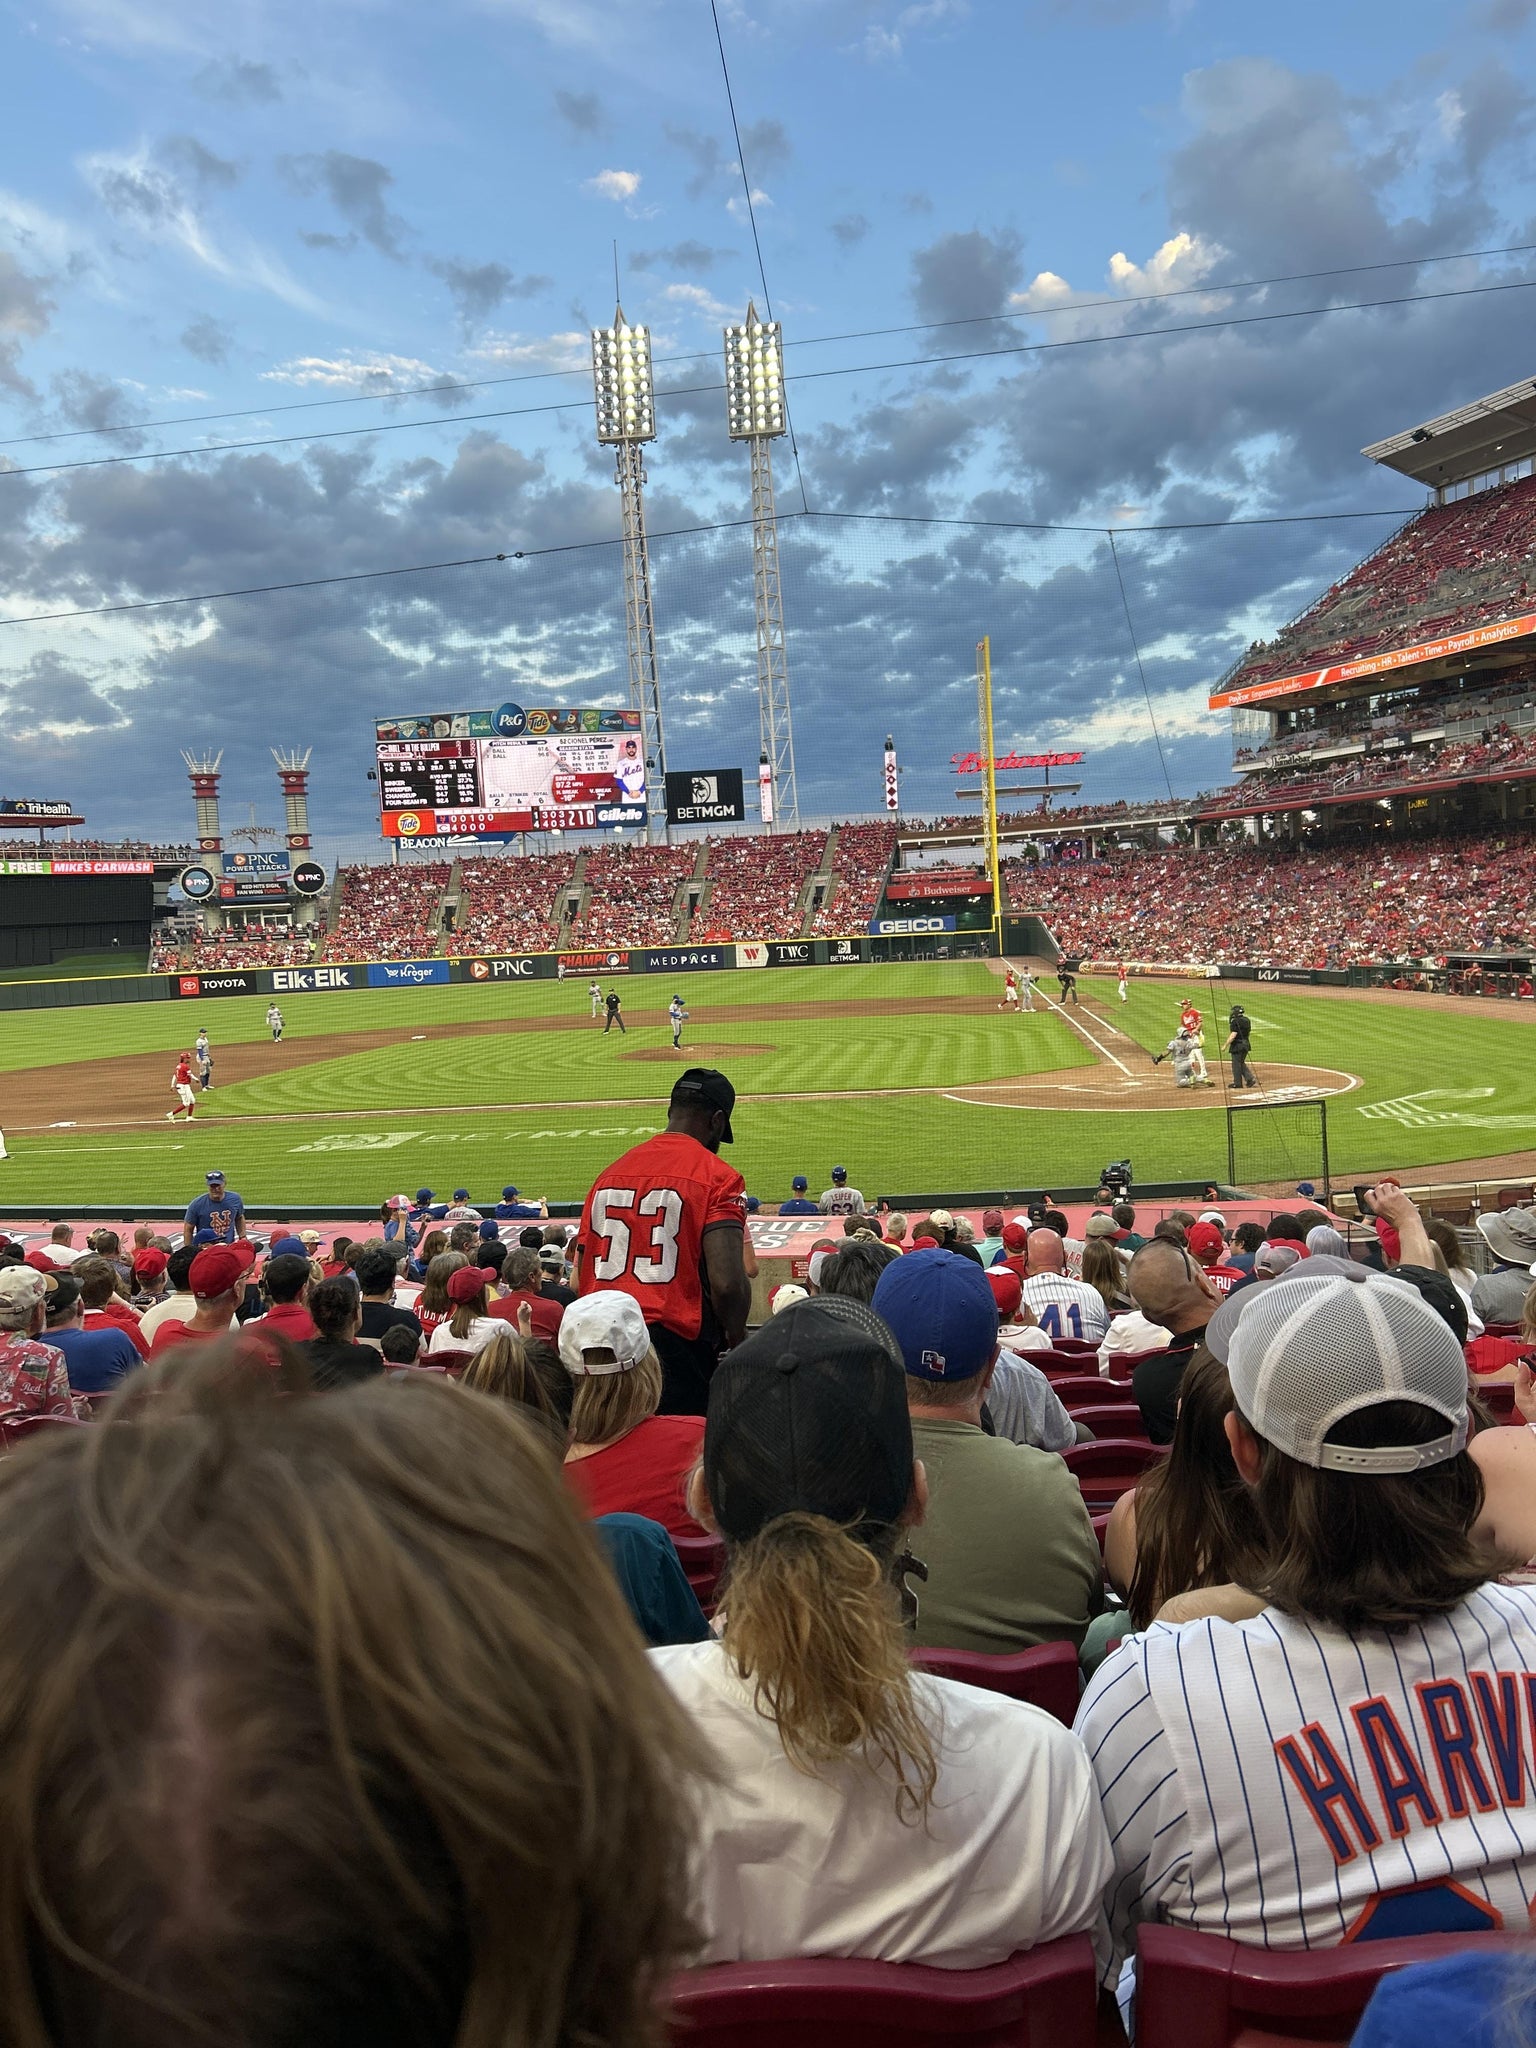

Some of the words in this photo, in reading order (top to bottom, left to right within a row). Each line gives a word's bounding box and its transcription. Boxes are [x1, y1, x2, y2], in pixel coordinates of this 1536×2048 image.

[1340, 662, 1377, 677] Recruiting
[1381, 658, 1392, 666] HR
[1398, 651, 1420, 663] Talent
[1424, 646, 1442, 656] Time
[1448, 635, 1474, 650] Payroll
[1481, 624, 1518, 642] Analytics
[1228, 692, 1249, 703] Paycor
[1252, 686, 1282, 699] Empowering
[499, 713, 522, 727] P&G
[528, 715, 548, 730] Tide
[622, 764, 642, 778] Mets
[26, 803, 71, 814] TriHealth
[598, 808, 643, 821] Gillette
[677, 804, 736, 819] BETMGM
[400, 819, 418, 830] Tide
[568, 810, 575, 826] 2
[578, 810, 584, 825] 1
[587, 810, 594, 825] 0
[232, 826, 276, 836] CINCINNATI
[400, 836, 446, 849] BEACON
[54, 861, 92, 872] MIKE'S
[94, 861, 150, 872] CARWASH
[248, 854, 278, 865] PNC
[9, 862, 44, 873] FREE
[924, 885, 972, 896] Budweiser
[879, 918, 944, 934] GEICO
[776, 945, 809, 958] TWC
[558, 952, 629, 967] CHAMPION
[650, 953, 718, 967] MEDPACE
[400, 963, 433, 982] Kroger
[491, 960, 533, 976] PNC
[1258, 970, 1279, 980] KIA
[202, 979, 246, 989] TOYOTA
[273, 969, 350, 990] Elk+Elk
[419, 1126, 669, 1143] BETMGM
[590, 1187, 683, 1284] 53
[1038, 1303, 1084, 1338] 41
[20, 1382, 43, 1395] Red
